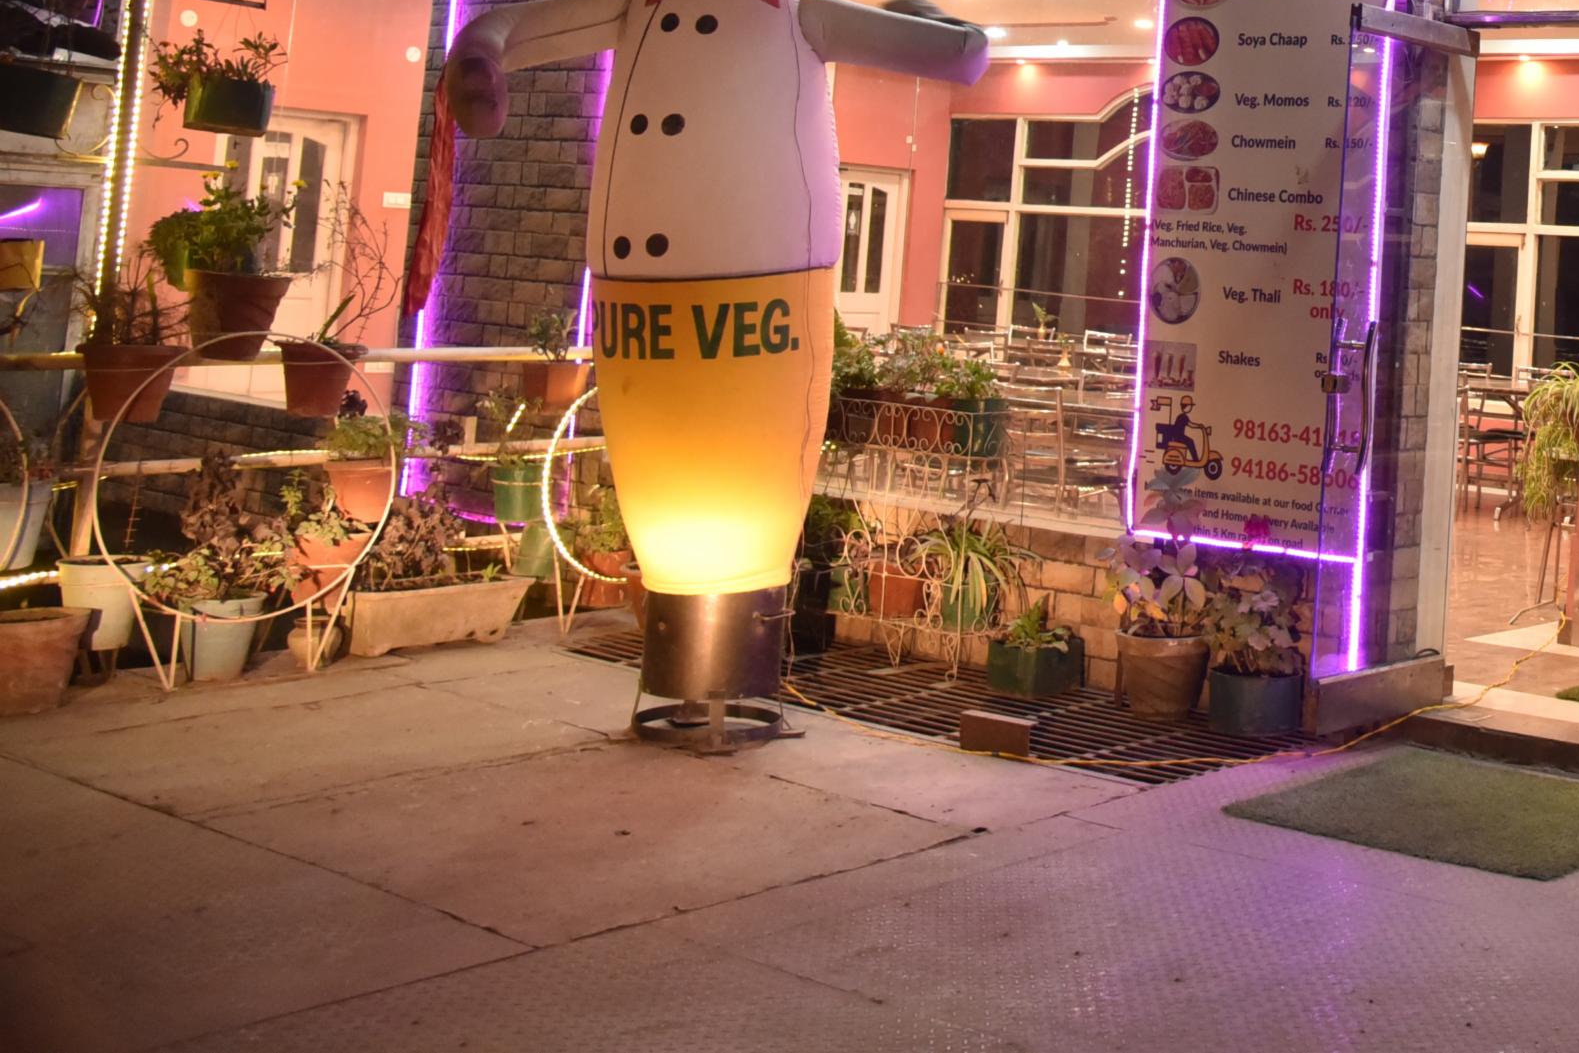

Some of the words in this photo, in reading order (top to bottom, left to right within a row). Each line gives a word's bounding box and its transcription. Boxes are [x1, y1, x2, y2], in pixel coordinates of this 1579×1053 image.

[1238, 33, 1267, 48] Soya
[1269, 33, 1308, 49] Chaap
[1331, 34, 1345, 45] Rs.
[1235, 93, 1260, 108] Veg.
[1263, 94, 1310, 107] Momos
[1328, 96, 1342, 108] Rs.
[1231, 135, 1296, 149] Chowmein
[1325, 137, 1339, 149] Rs.
[1228, 187, 1275, 202] Chinese
[1279, 189, 1323, 204] Combo
[1176, 219, 1199, 231] Fried
[1202, 221, 1224, 234] Rice,
[1227, 222, 1247, 235] Veg.
[1294, 214, 1316, 231] Rs.
[1210, 239, 1229, 252] Veg.
[1232, 240, 1288, 255] Chowmein)
[1223, 286, 1248, 303] Veg.
[1250, 287, 1281, 303] Thali
[1293, 279, 1314, 296] Rs.
[691, 299, 800, 359] VEG.
[1218, 350, 1260, 367] Shakes
[1316, 352, 1328, 364] Rs
[1194, 487, 1218, 500] items
[1221, 491, 1260, 505] available
[1262, 497, 1271, 507] at
[1273, 499, 1289, 508] our
[1291, 499, 1313, 511] food
